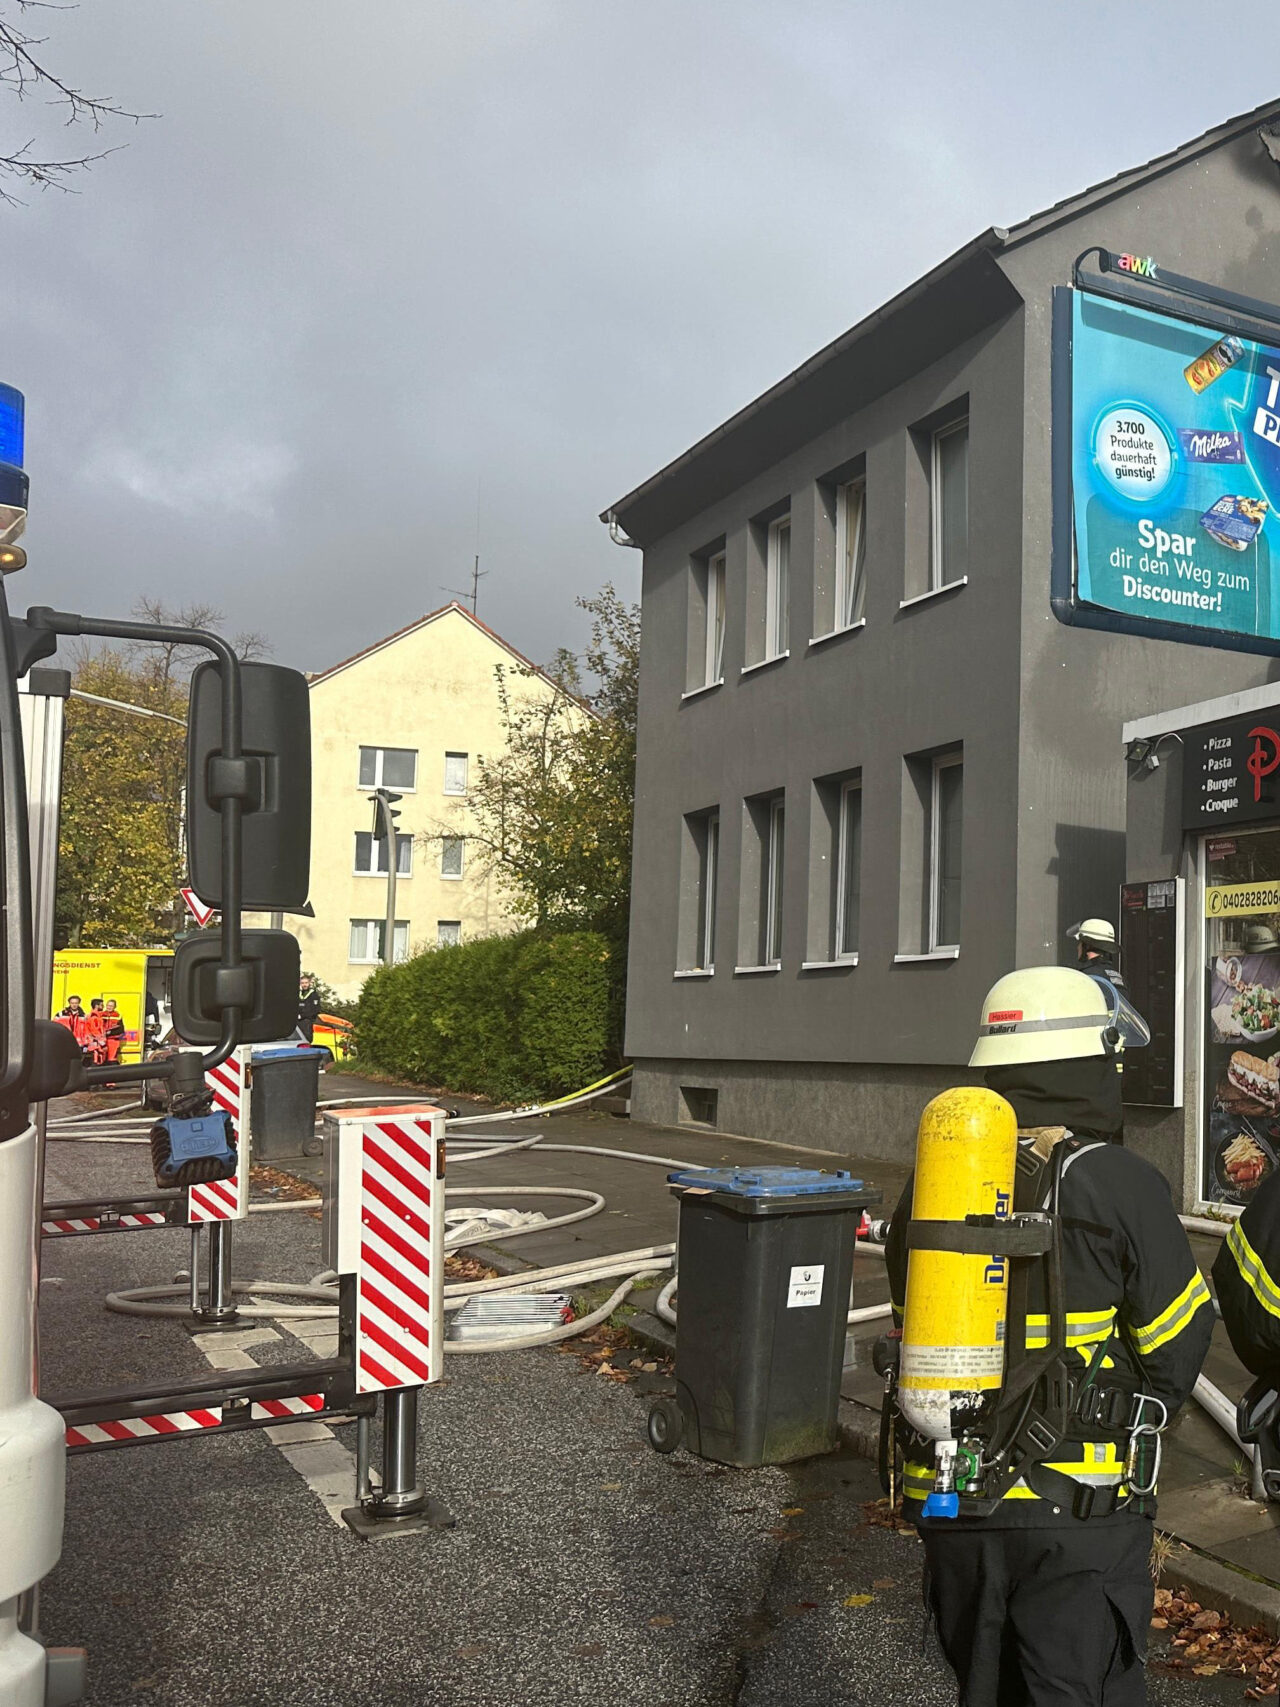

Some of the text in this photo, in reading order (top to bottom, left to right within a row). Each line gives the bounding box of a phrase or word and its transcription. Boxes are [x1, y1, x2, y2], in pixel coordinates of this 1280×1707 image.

[1118, 253, 1159, 279] awk
[1116, 420, 1145, 435] 3.700
[1110, 435, 1154, 451] Produkte
[1190, 432, 1232, 457] Milka
[1110, 450, 1157, 466] dauerhaft
[1115, 465, 1156, 481] günstig!
[1138, 519, 1196, 558] Spar
[1110, 547, 1250, 591] dir den Weg zum
[1122, 575, 1222, 612] Discounter!
[1208, 737, 1232, 751] Pizza
[1208, 757, 1232, 771] Pasta
[1206, 777, 1238, 792] Burger
[1205, 798, 1239, 813] Croque
